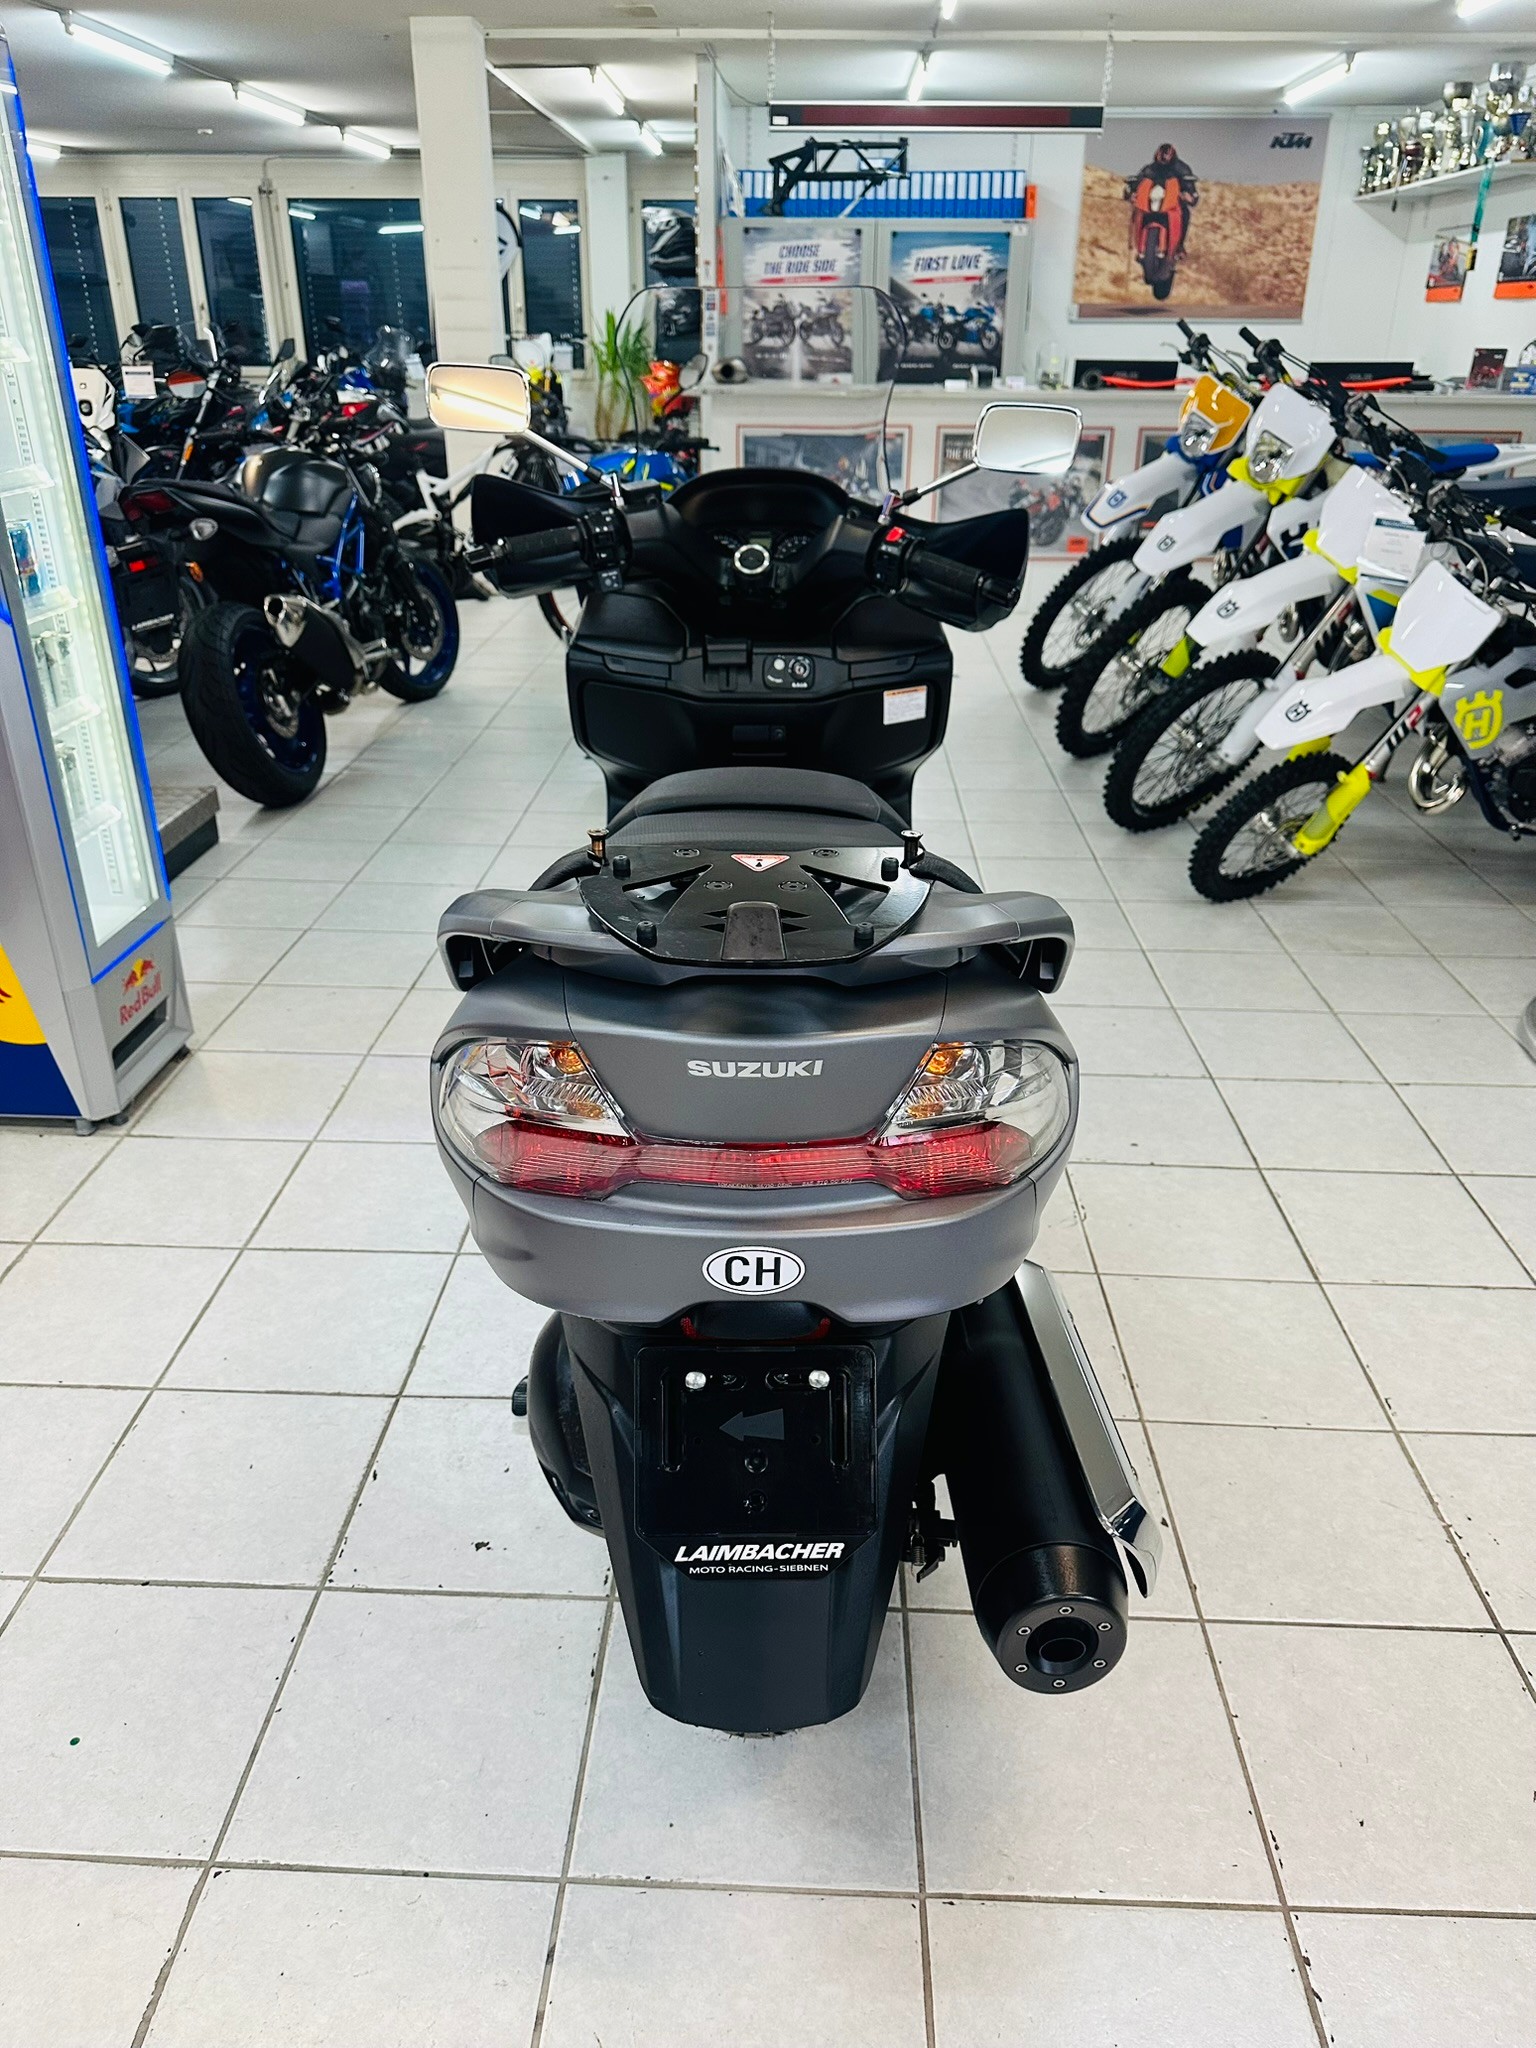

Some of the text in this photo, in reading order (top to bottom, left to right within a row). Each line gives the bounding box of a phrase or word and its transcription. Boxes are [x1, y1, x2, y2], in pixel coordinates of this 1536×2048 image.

[1270, 132, 1312, 149] KTM
[779, 244, 820, 258] CHOOSE
[764, 259, 837, 274] THE RIDE SIDE
[914, 253, 983, 272] FIRST LOVE
[120, 972, 161, 1025] Red Bull
[687, 1060, 824, 1078] SUZUKI
[724, 1256, 782, 1287] CH
[675, 1543, 845, 1562] LAIMBACHER
[689, 1564, 829, 1574] MOTO RACING-SIEBNEN
